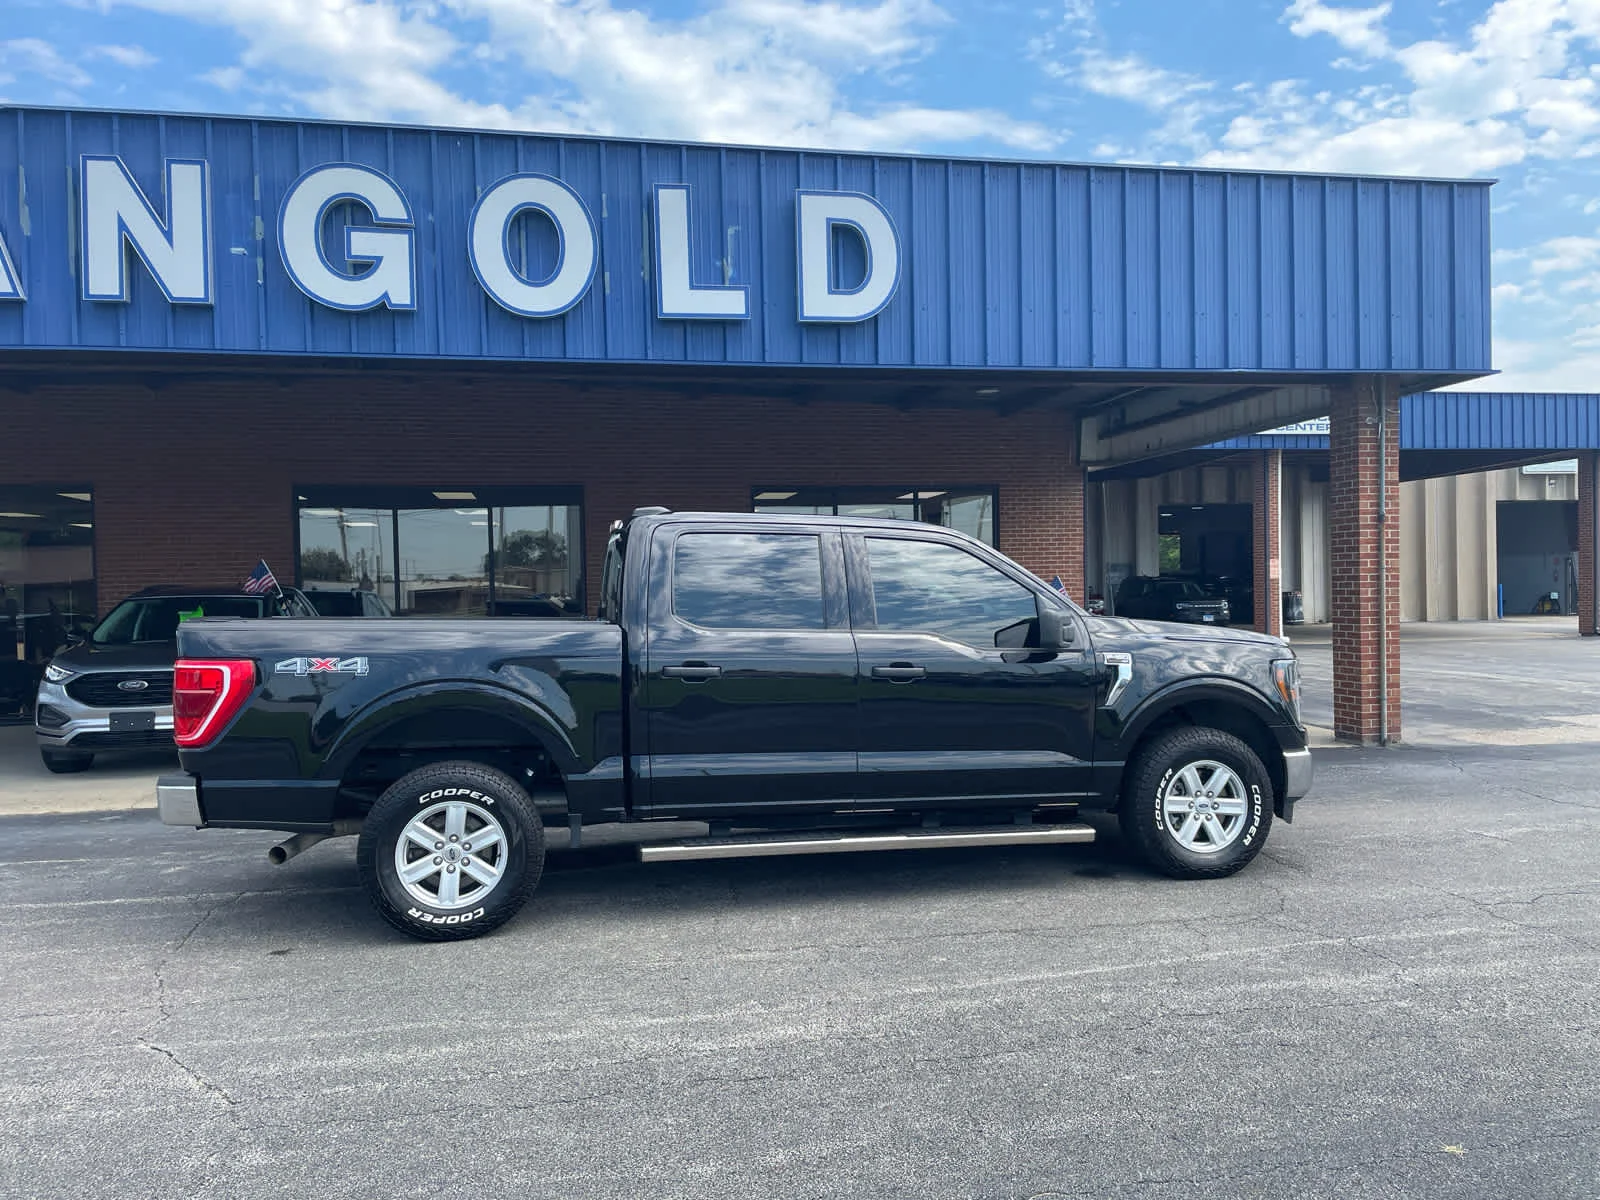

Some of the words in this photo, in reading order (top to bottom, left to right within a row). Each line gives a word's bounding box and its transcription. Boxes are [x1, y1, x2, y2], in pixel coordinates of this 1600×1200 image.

[0, 154, 902, 322] NGOLD
[419, 788, 495, 805] COOPER
[1155, 768, 1172, 830] COOPER
[1243, 784, 1261, 845] COOPER
[408, 907, 485, 924] COOPER
